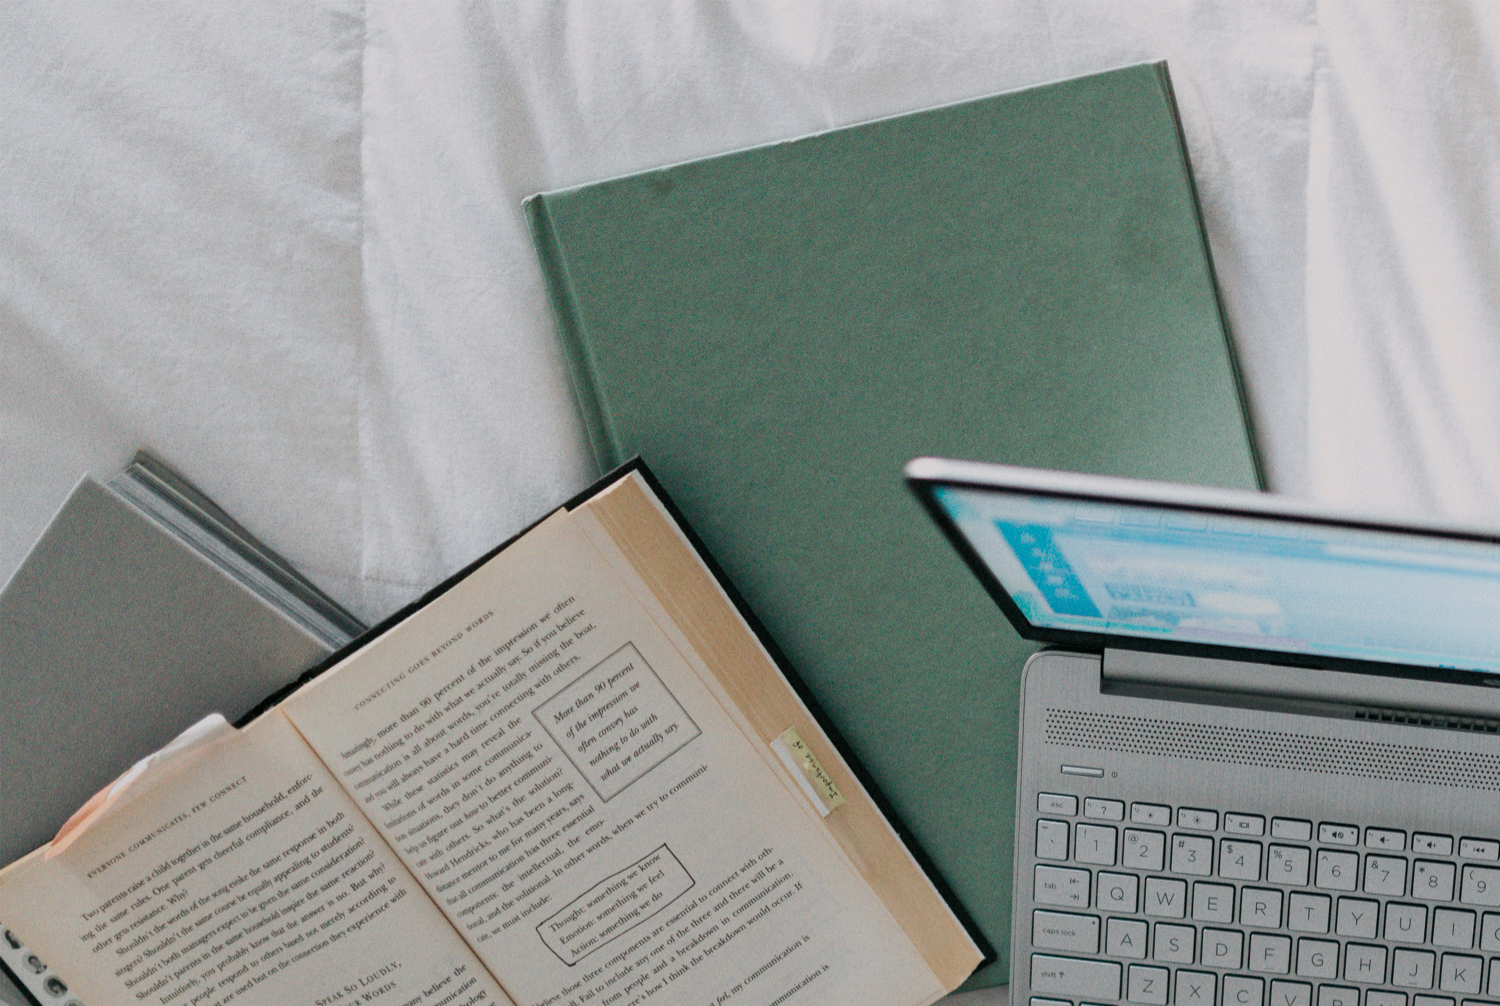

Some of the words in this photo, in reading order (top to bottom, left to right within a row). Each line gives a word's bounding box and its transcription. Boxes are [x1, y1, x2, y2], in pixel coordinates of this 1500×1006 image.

[354, 672, 407, 711] CONNECTING
[407, 655, 431, 675] GOES
[430, 631, 464, 658] BEYOND
[464, 610, 495, 633] WORDS
[552, 705, 575, 725] More
[574, 691, 595, 709] than
[593, 680, 607, 695] 90
[606, 662, 635, 690] percent
[565, 725, 576, 740] of
[574, 719, 588, 733] the
[587, 690, 629, 723] impression
[628, 681, 641, 693] we
[577, 735, 598, 754] often
[597, 716, 624, 739] convey
[622, 705, 639, 720] has
[588, 741, 622, 767] nothing
[619, 735, 629, 745] to
[629, 727, 640, 739] do
[639, 712, 659, 730] with
[600, 762, 621, 782] what
[620, 754, 633, 767] we
[632, 732, 664, 759] actually
[663, 722, 680, 736] say.
[86, 851, 127, 880] EVERYONE
[127, 812, 192, 853] COMMUNICATES,
[190, 800, 208, 814] FEW
[208, 775, 247, 803] CONNECT
[1139, 844, 1148, 857] 2
[1187, 849, 1196, 862] 3
[1234, 855, 1244, 866] 4
[1283, 859, 1293, 872] 5
[1331, 864, 1341, 877] 6
[1381, 869, 1390, 882] 7
[1428, 874, 1438, 888] 8
[1476, 880, 1486, 893] 9
[548, 906, 587, 933] Thought:
[586, 877, 629, 909] something
[626, 869, 639, 881] we
[637, 853, 661, 873] know
[1109, 886, 1124, 901] Q
[1156, 891, 1174, 906] W
[558, 918, 597, 946] Emotion:
[595, 890, 639, 922] something
[636, 882, 649, 893] we
[647, 868, 666, 885] feel
[1207, 896, 1217, 911] E
[1254, 901, 1266, 915] R
[1304, 906, 1314, 920] T
[1351, 911, 1363, 925] Y
[570, 935, 599, 958] Action:
[598, 907, 642, 939] something
[638, 899, 651, 911] we
[651, 891, 664, 903] do
[1398, 917, 1411, 931] U
[1120, 932, 1133, 946] A
[1169, 937, 1179, 952] S
[1215, 942, 1228, 956] D
[1263, 947, 1274, 960] F
[1310, 952, 1323, 967] G
[1358, 957, 1371, 971] H
[1408, 963, 1418, 977] J
[1454, 968, 1466, 982] K
[343, 983, 358, 995] SO
[354, 960, 402, 990] LOUDLY,
[360, 980, 397, 1002] WORDS
[1142, 978, 1154, 993] Z
[1189, 984, 1200, 998] X
[1236, 989, 1248, 1003] C
